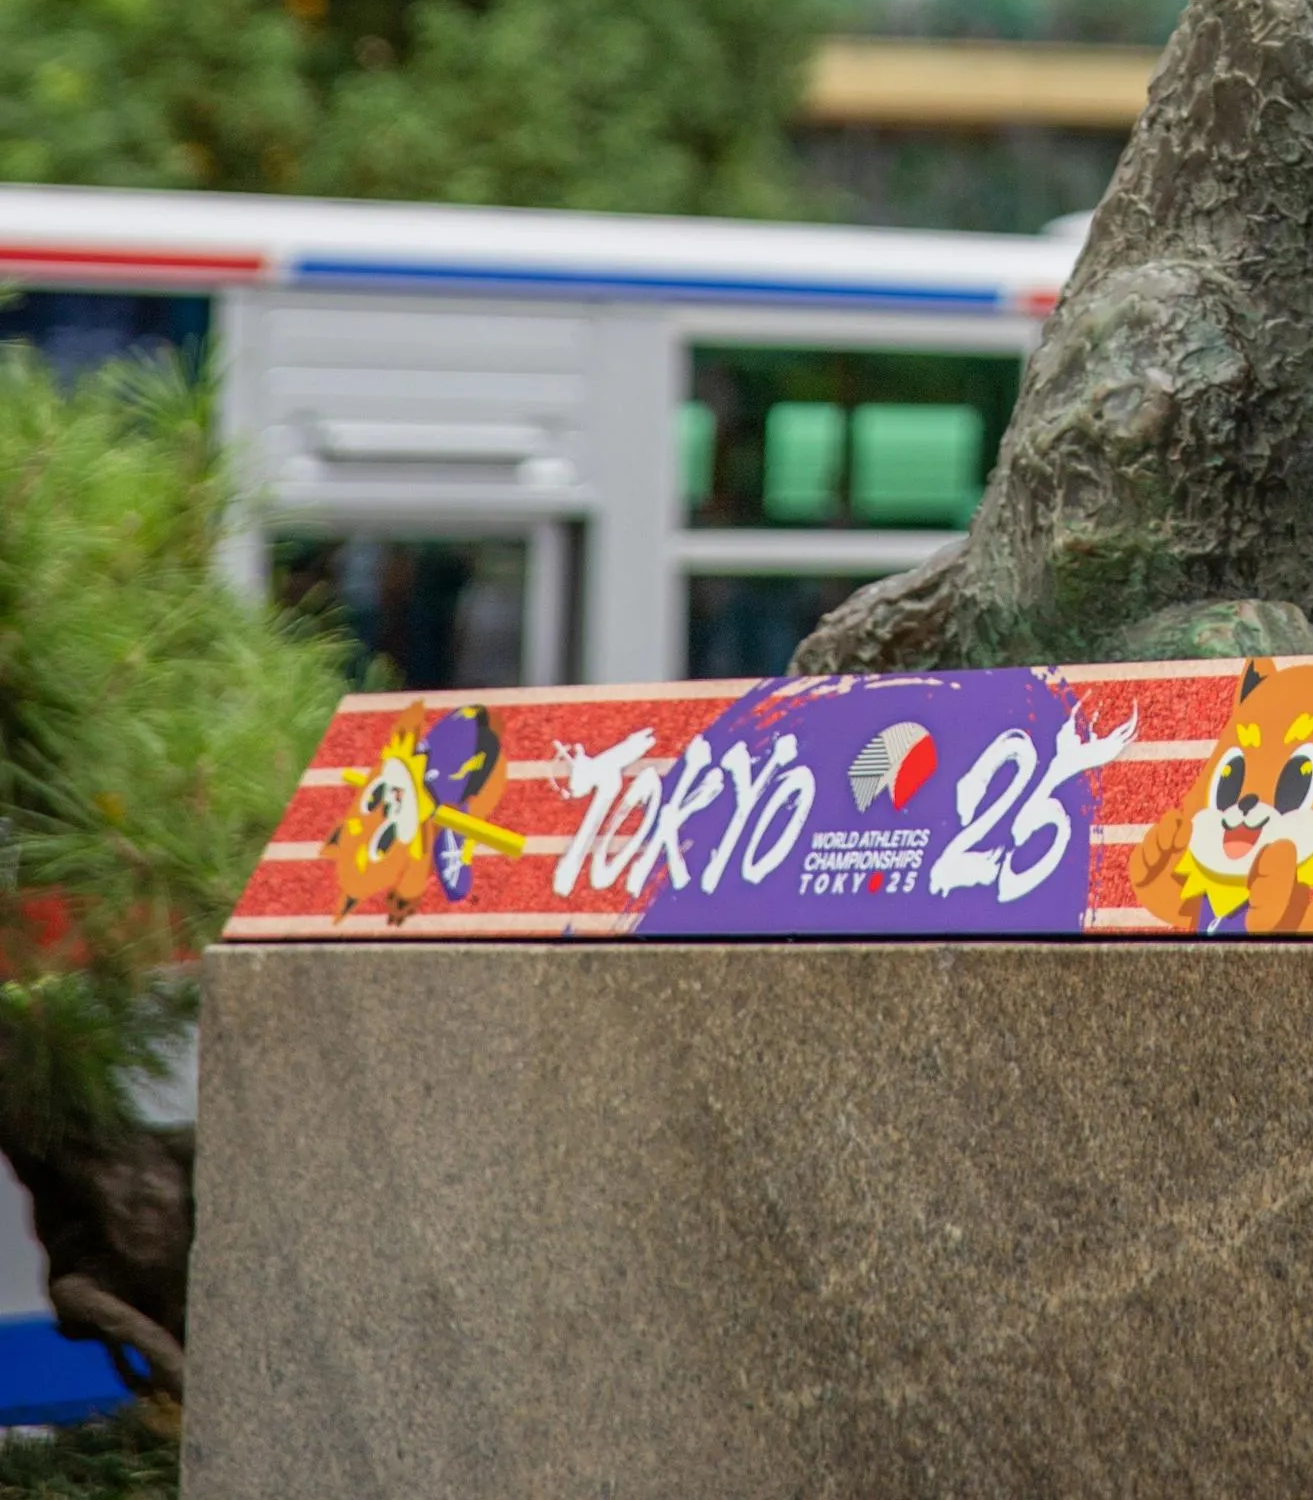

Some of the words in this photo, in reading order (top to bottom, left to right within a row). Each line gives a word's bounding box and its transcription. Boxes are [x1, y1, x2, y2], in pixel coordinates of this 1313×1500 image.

[553, 728, 815, 897] TOKYO
[929, 692, 1138, 902] 25
[812, 831, 859, 849] WORLD
[859, 829, 930, 848] ATHLETICS
[804, 850, 923, 871] CHAMPIONSHIPS
